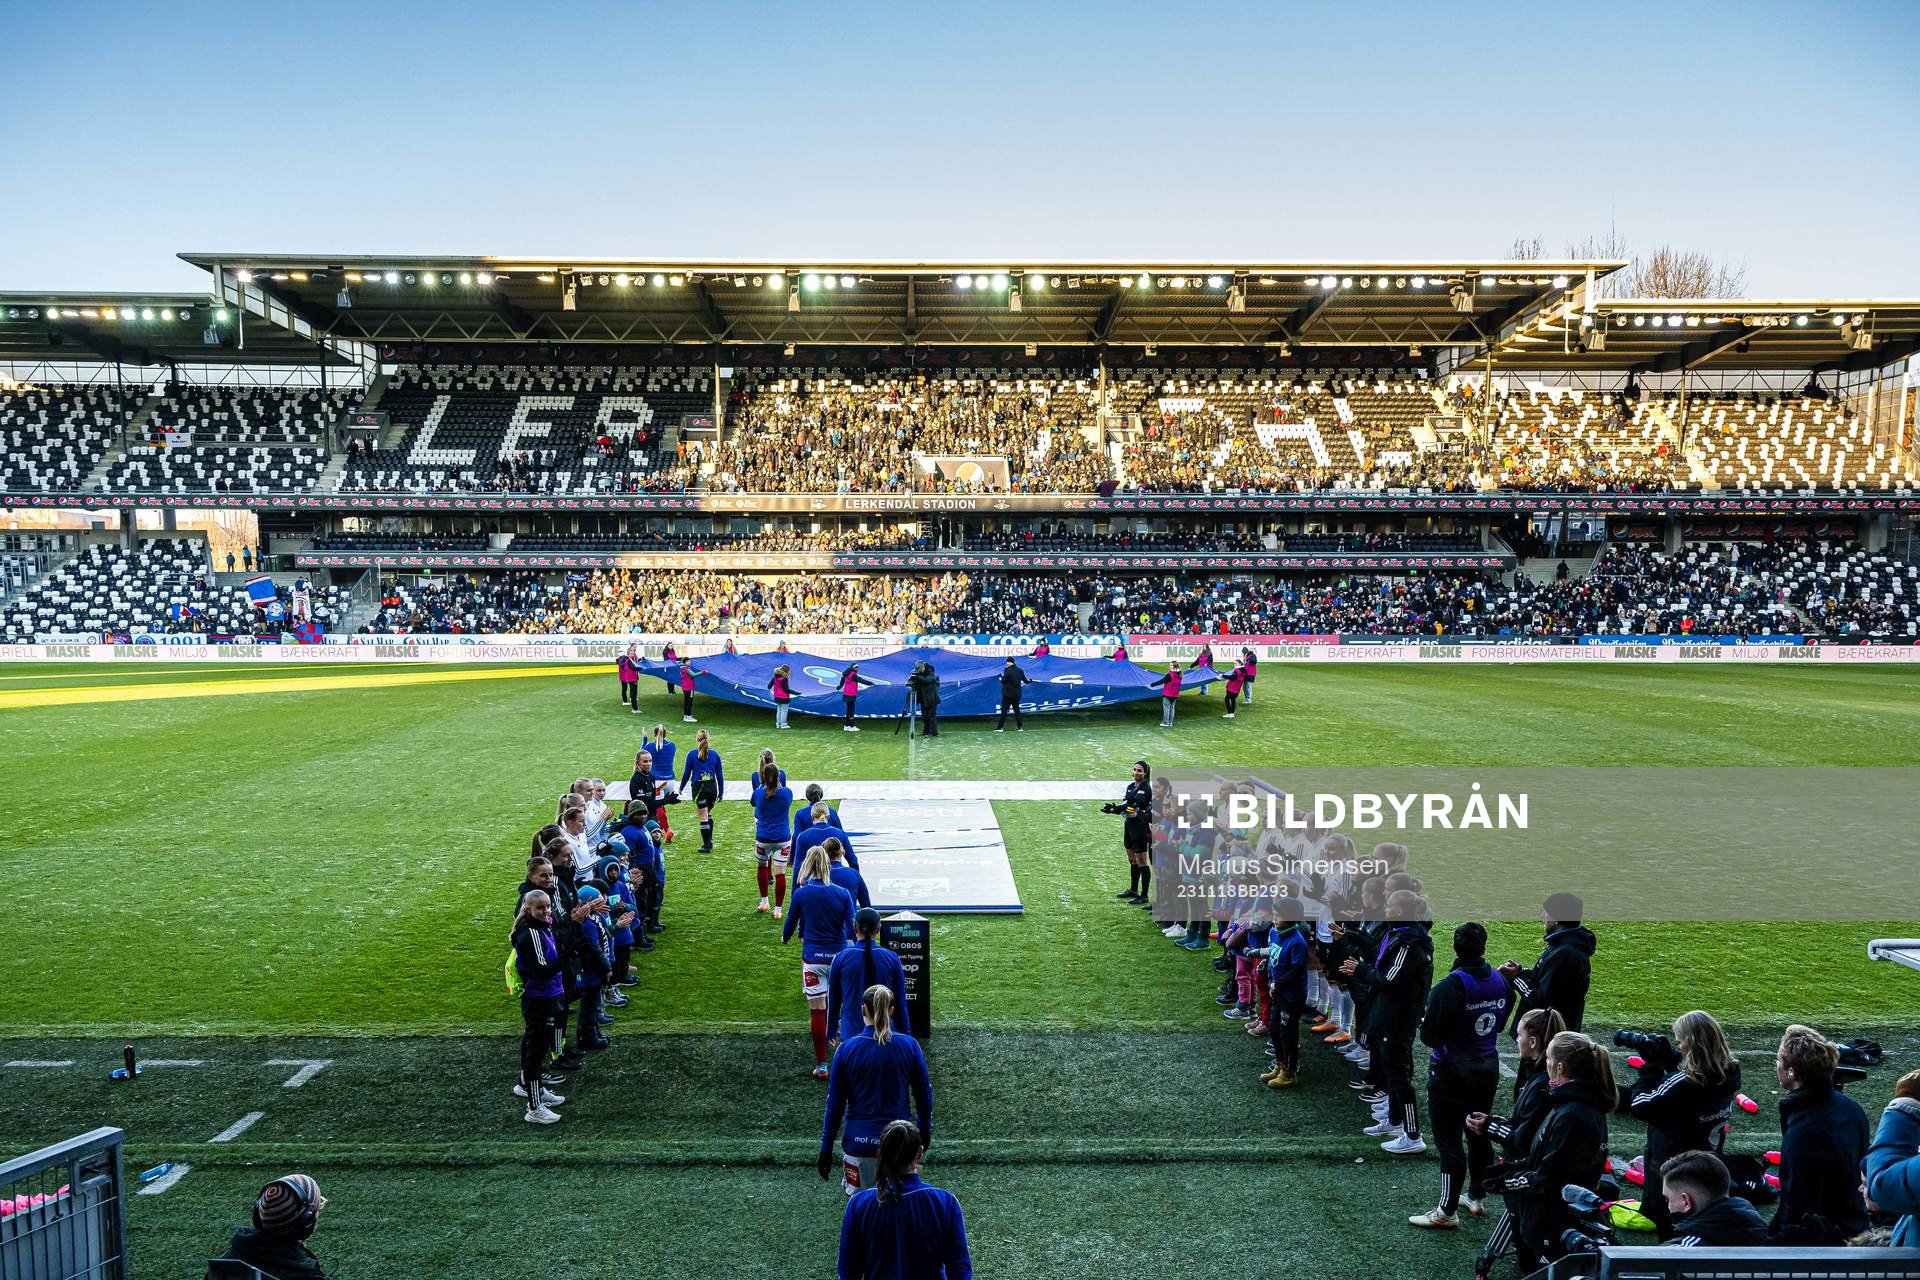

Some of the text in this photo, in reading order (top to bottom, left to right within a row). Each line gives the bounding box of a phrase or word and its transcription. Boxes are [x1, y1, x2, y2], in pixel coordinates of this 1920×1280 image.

[845, 499, 976, 509] LERKENDAL STADION
[45, 646, 91, 658] MASKE
[114, 646, 158, 658] MASKE
[169, 646, 208, 658] MILJØ
[218, 646, 263, 658] MASKE
[281, 646, 359, 658] BÆREKRAFT
[375, 646, 419, 658] MASKE
[429, 646, 569, 658] FORBRUKSMATERIELL
[577, 646, 620, 658] MASKE
[955, 646, 1091, 658] FORBRUKSMERIELL
[1166, 646, 1203, 658] MASK
[1267, 646, 1310, 658] MASKE
[1328, 647, 1404, 659] BÆREKRAFT
[1419, 647, 1462, 659] MASKE
[1472, 647, 1606, 659] FORBRUKSMATERIELL
[1614, 647, 1657, 659] MASKE
[1679, 647, 1722, 659] MASKE
[1732, 647, 1769, 659] MILJØ
[1778, 647, 1821, 659] MASKE
[1838, 647, 1913, 659] BÆREKRAFT
